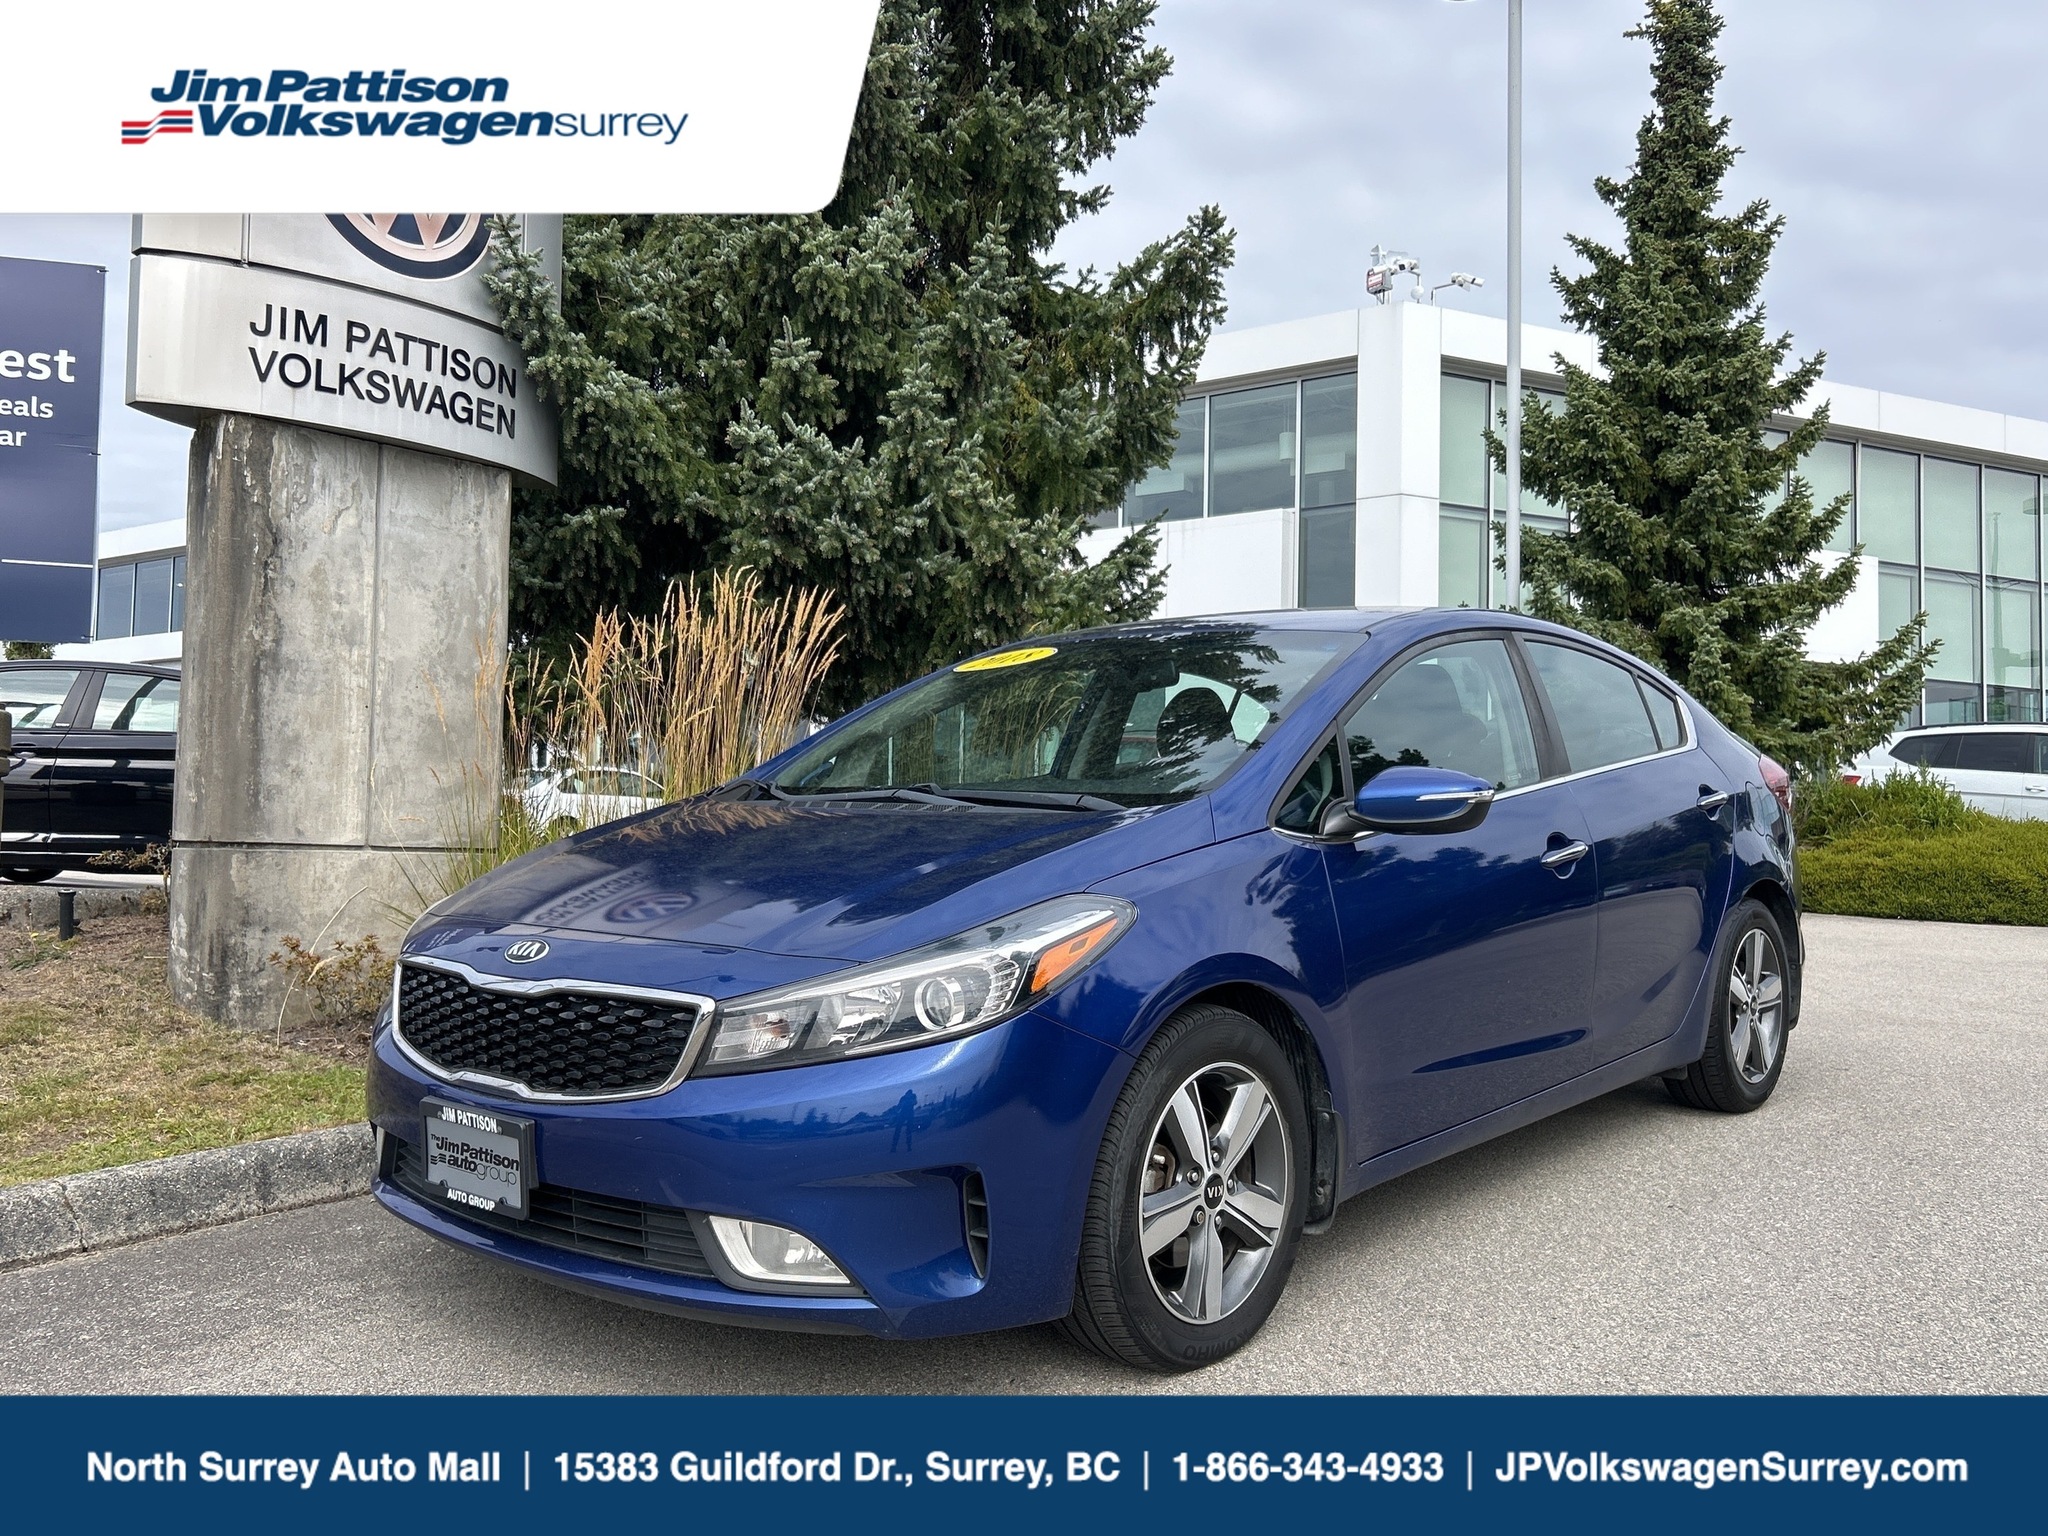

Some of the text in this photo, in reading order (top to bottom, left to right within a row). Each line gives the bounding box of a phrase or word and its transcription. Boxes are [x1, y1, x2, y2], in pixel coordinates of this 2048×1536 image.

[249, 303, 517, 399] JIM PATTISON
[248, 346, 516, 440] VOLKSWAGEN
[507, 941, 542, 958] KIA
[441, 1106, 498, 1133] JIM PATTISON
[447, 1188, 496, 1211] AUTO GROUP
[1207, 1184, 1224, 1199] KIA
